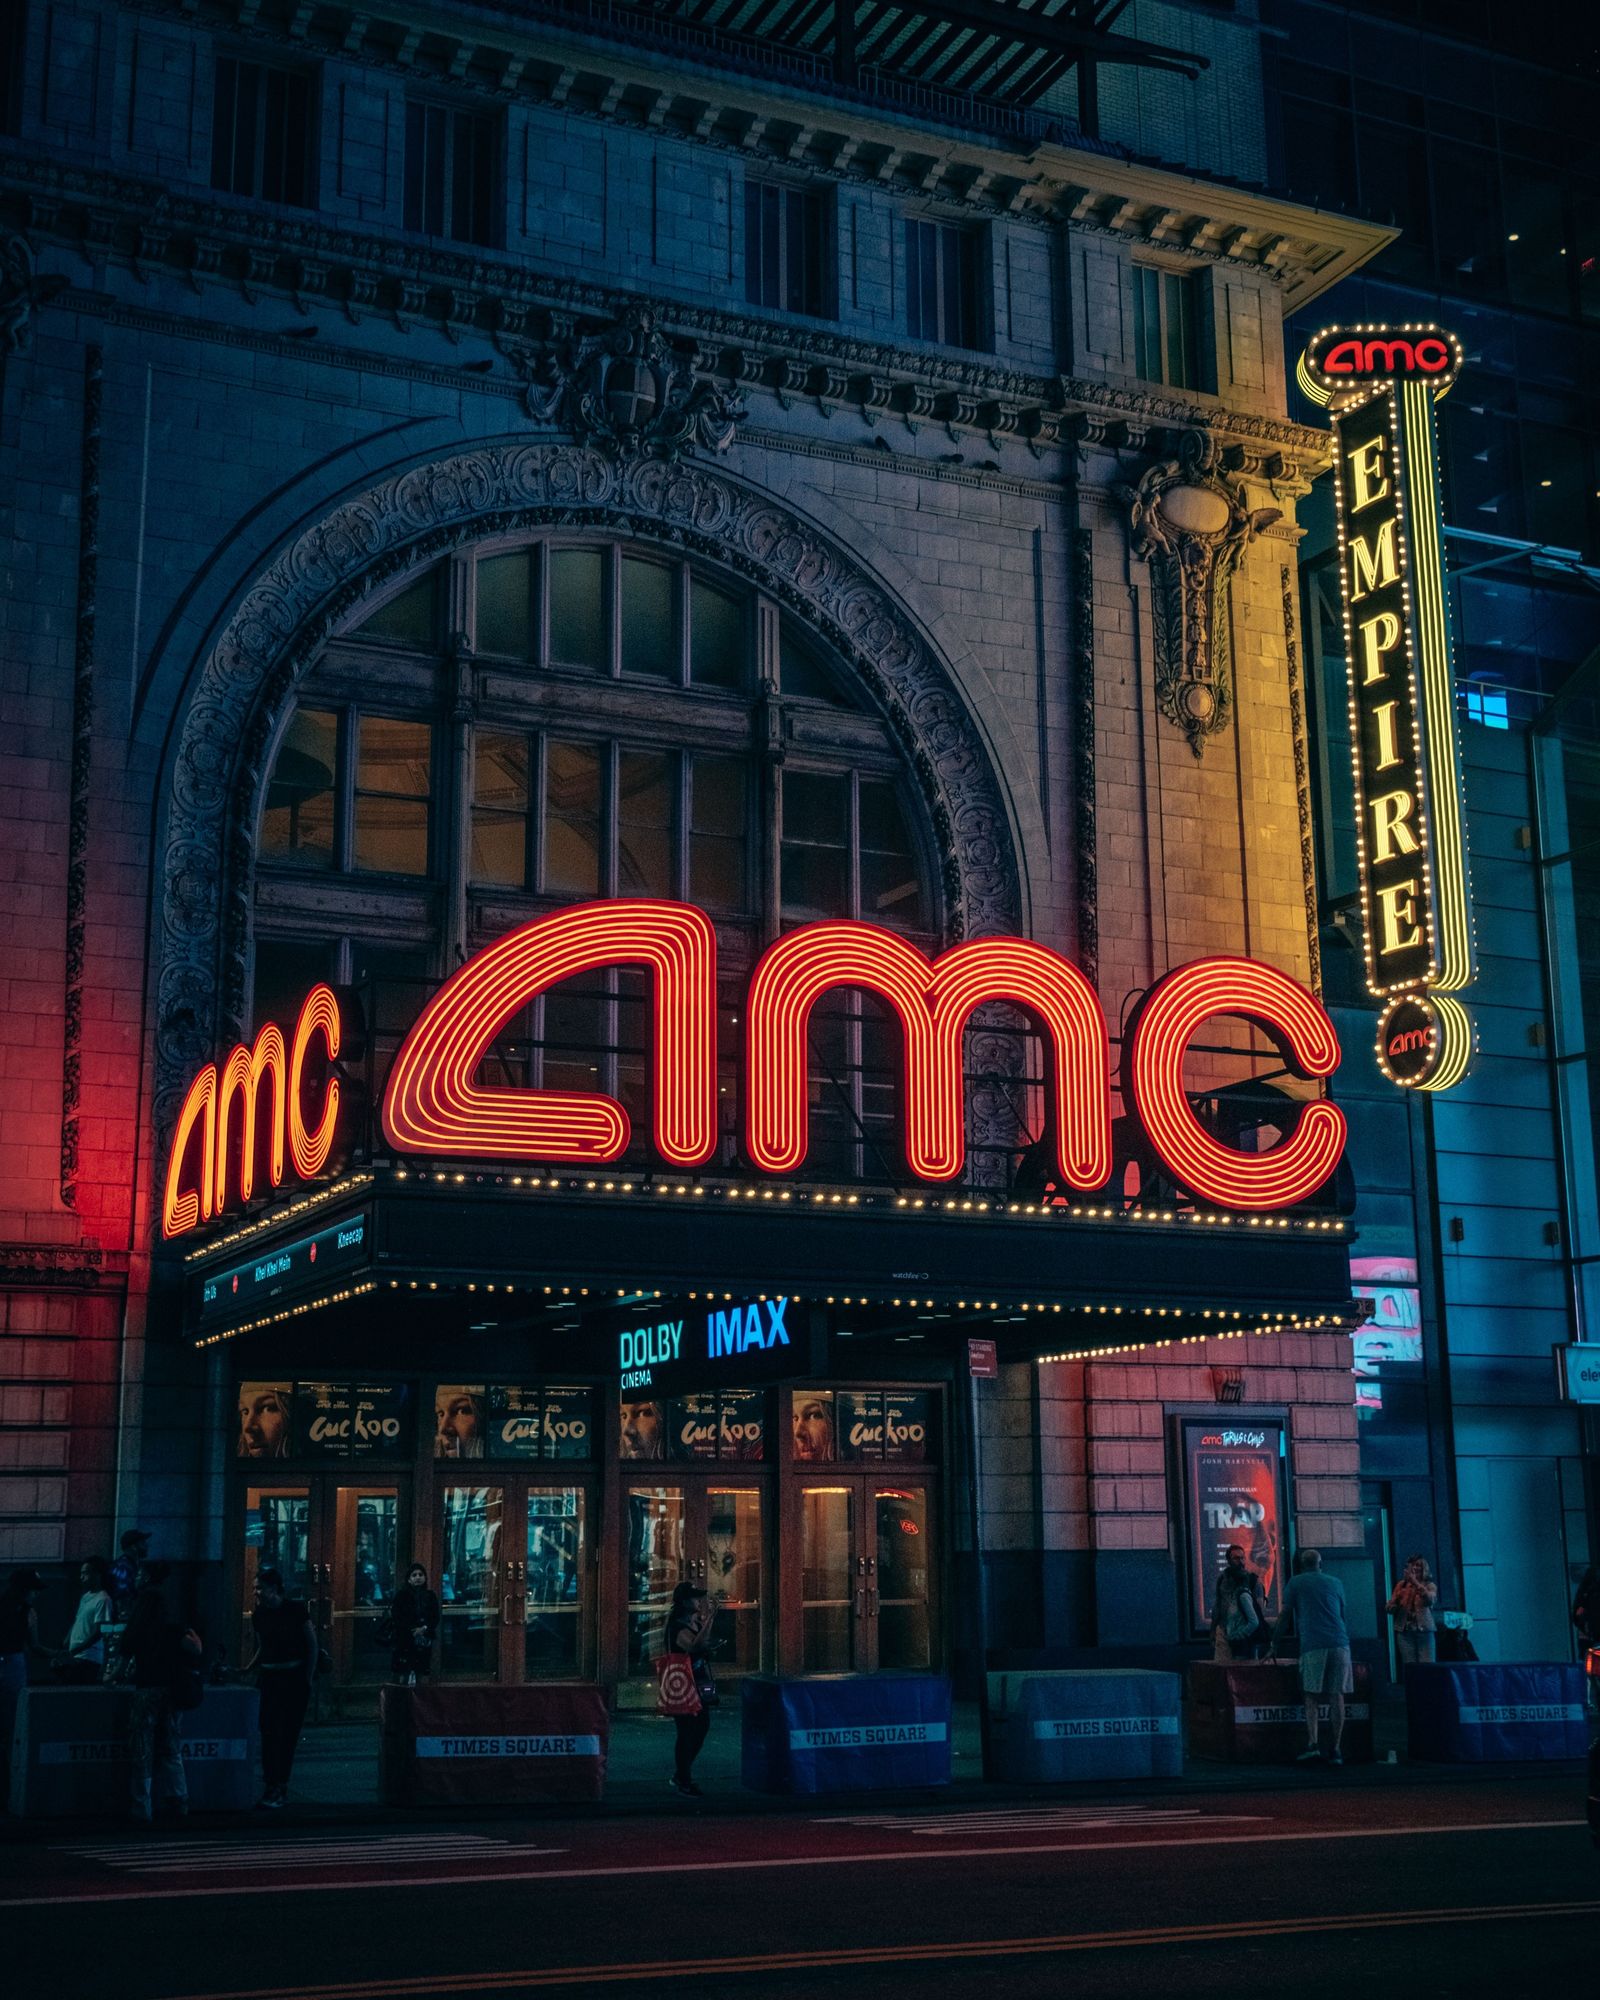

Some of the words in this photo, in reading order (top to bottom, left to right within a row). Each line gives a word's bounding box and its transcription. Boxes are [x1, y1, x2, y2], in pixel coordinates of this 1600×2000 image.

[1323, 339, 1449, 373] amc
[1348, 434, 1423, 956] EMPIRE
[382, 897, 1348, 1209] amc
[1389, 1025, 1434, 1056] amc
[163, 982, 341, 1241] amc
[337, 1226, 364, 1249] Kneecap
[278, 1254, 291, 1274] Mein
[707, 1296, 791, 1359] IMAX
[620, 1320, 684, 1369] DOLBY
[620, 1369, 652, 1390] CINEMA
[309, 1410, 400, 1442] Cuckoo
[501, 1412, 586, 1443] Cuckoo
[681, 1414, 761, 1445] Cuckoo
[849, 1417, 924, 1446] Cuckoo
[1201, 1435, 1223, 1446] amc
[1204, 1502, 1265, 1528] TRAP
[1053, 1722, 1100, 1736] TIMES
[1103, 1720, 1159, 1734] SQUARE
[1253, 1708, 1297, 1721] TIMES
[1477, 1708, 1517, 1720] TIMES
[1520, 1707, 1568, 1720] SQUARE
[441, 1740, 500, 1755] TIMES
[505, 1738, 576, 1754] SQUARE
[807, 1730, 861, 1745] TIMES
[865, 1727, 927, 1742] SQUARE
